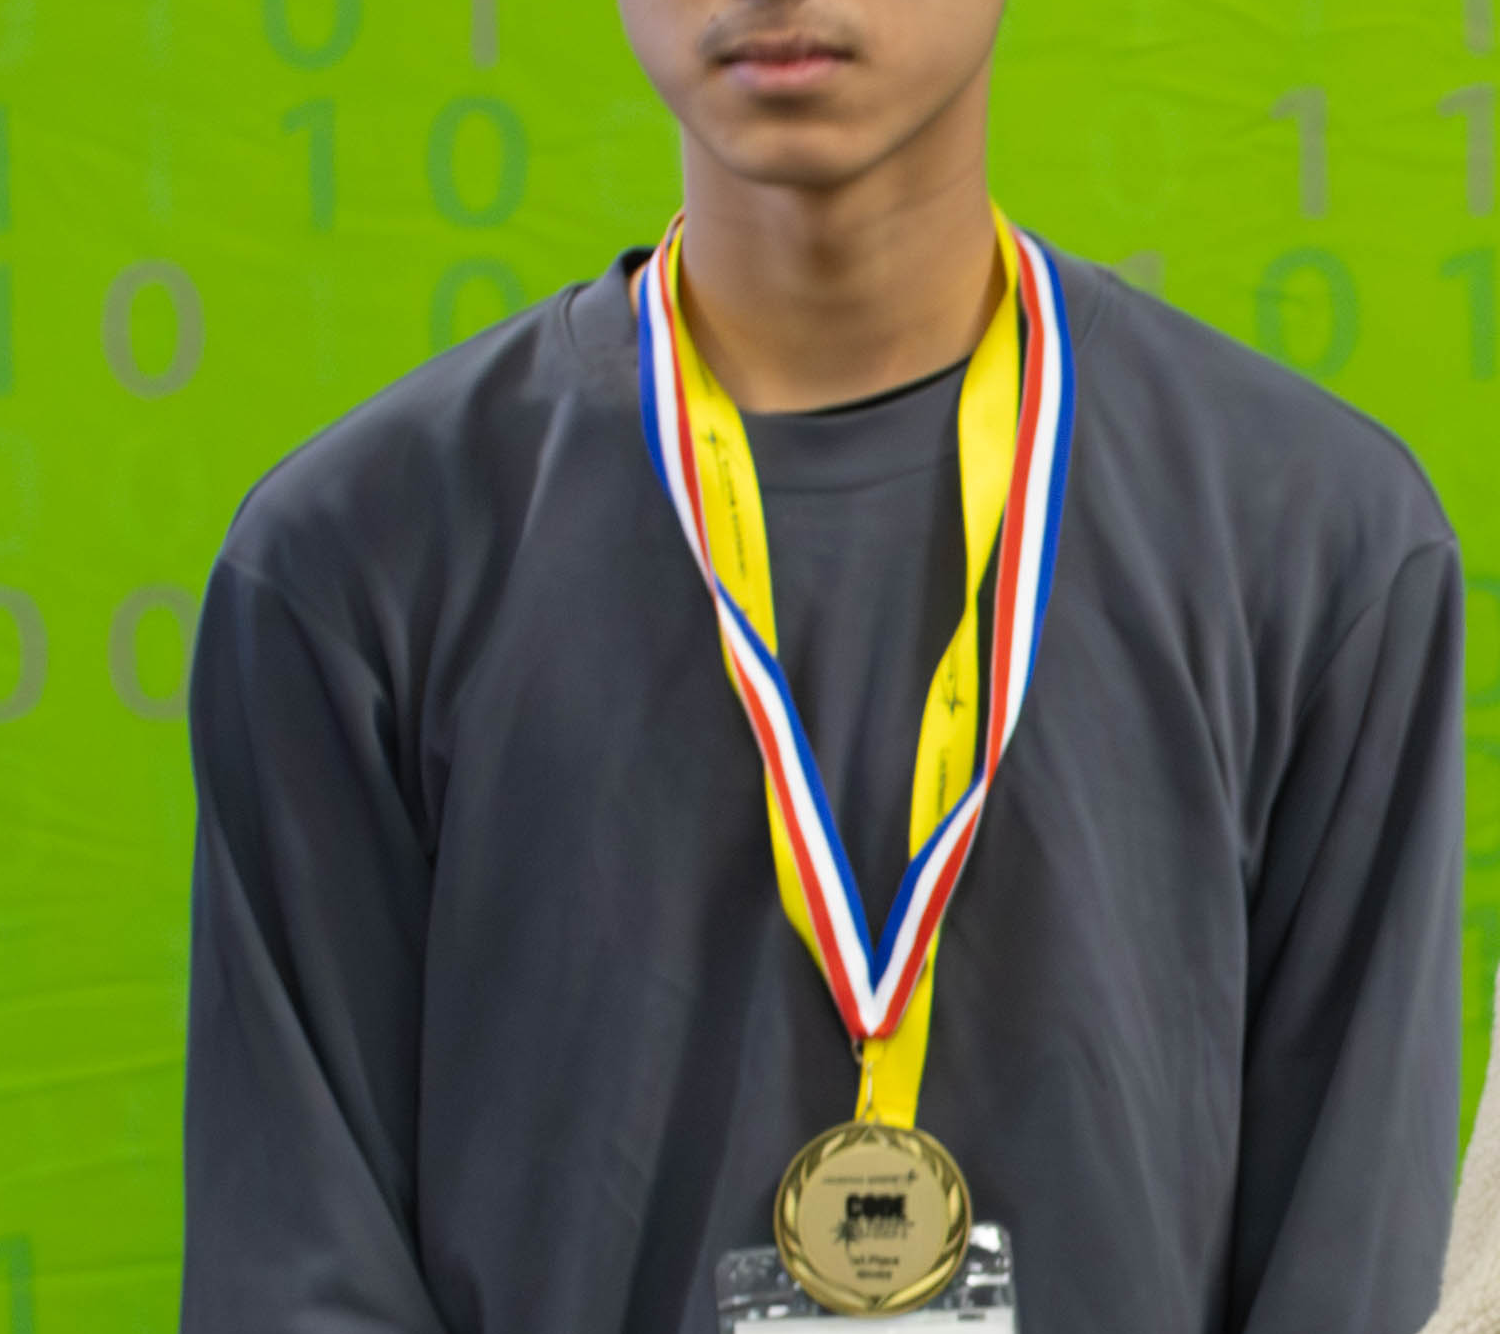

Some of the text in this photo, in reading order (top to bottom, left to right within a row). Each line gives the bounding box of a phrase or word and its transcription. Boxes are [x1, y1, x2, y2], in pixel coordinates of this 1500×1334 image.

[281, 97, 335, 233] 1
[427, 94, 528, 231] 0
[1271, 85, 1329, 220] 1
[1438, 82, 1496, 218] 1
[102, 259, 205, 399] 0
[1439, 245, 1498, 383] 1
[846, 1193, 908, 1221] CODE
